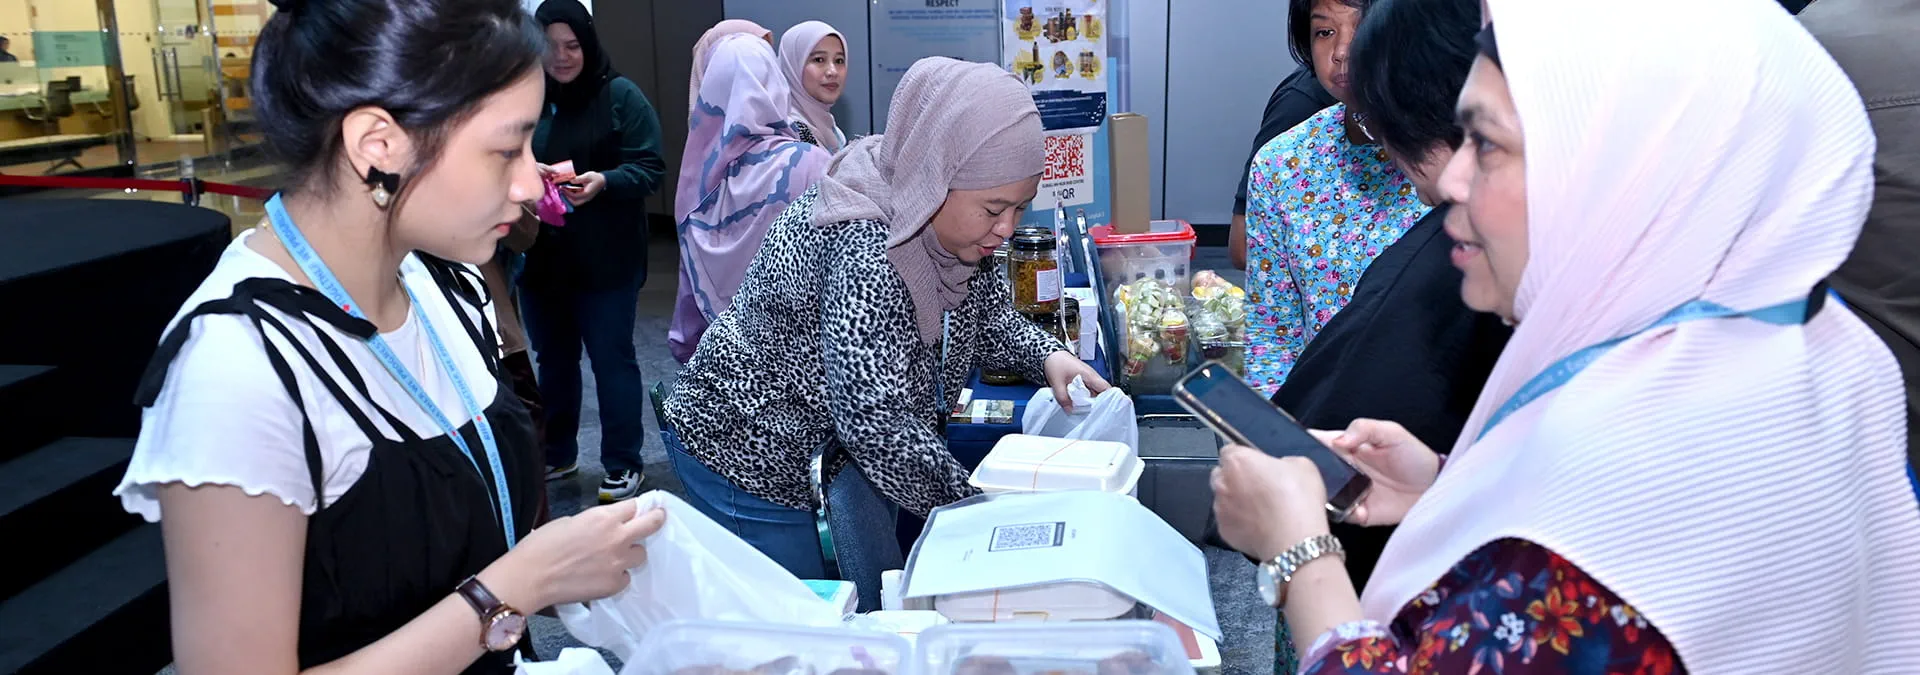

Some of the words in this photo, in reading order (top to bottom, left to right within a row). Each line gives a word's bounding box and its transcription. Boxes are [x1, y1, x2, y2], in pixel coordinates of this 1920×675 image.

[1061, 187, 1075, 199] QR
[295, 245, 312, 262] WE
[307, 259, 347, 307] TOGETHER
[369, 335, 408, 381] PROGRESS
[405, 378, 420, 394] WE
